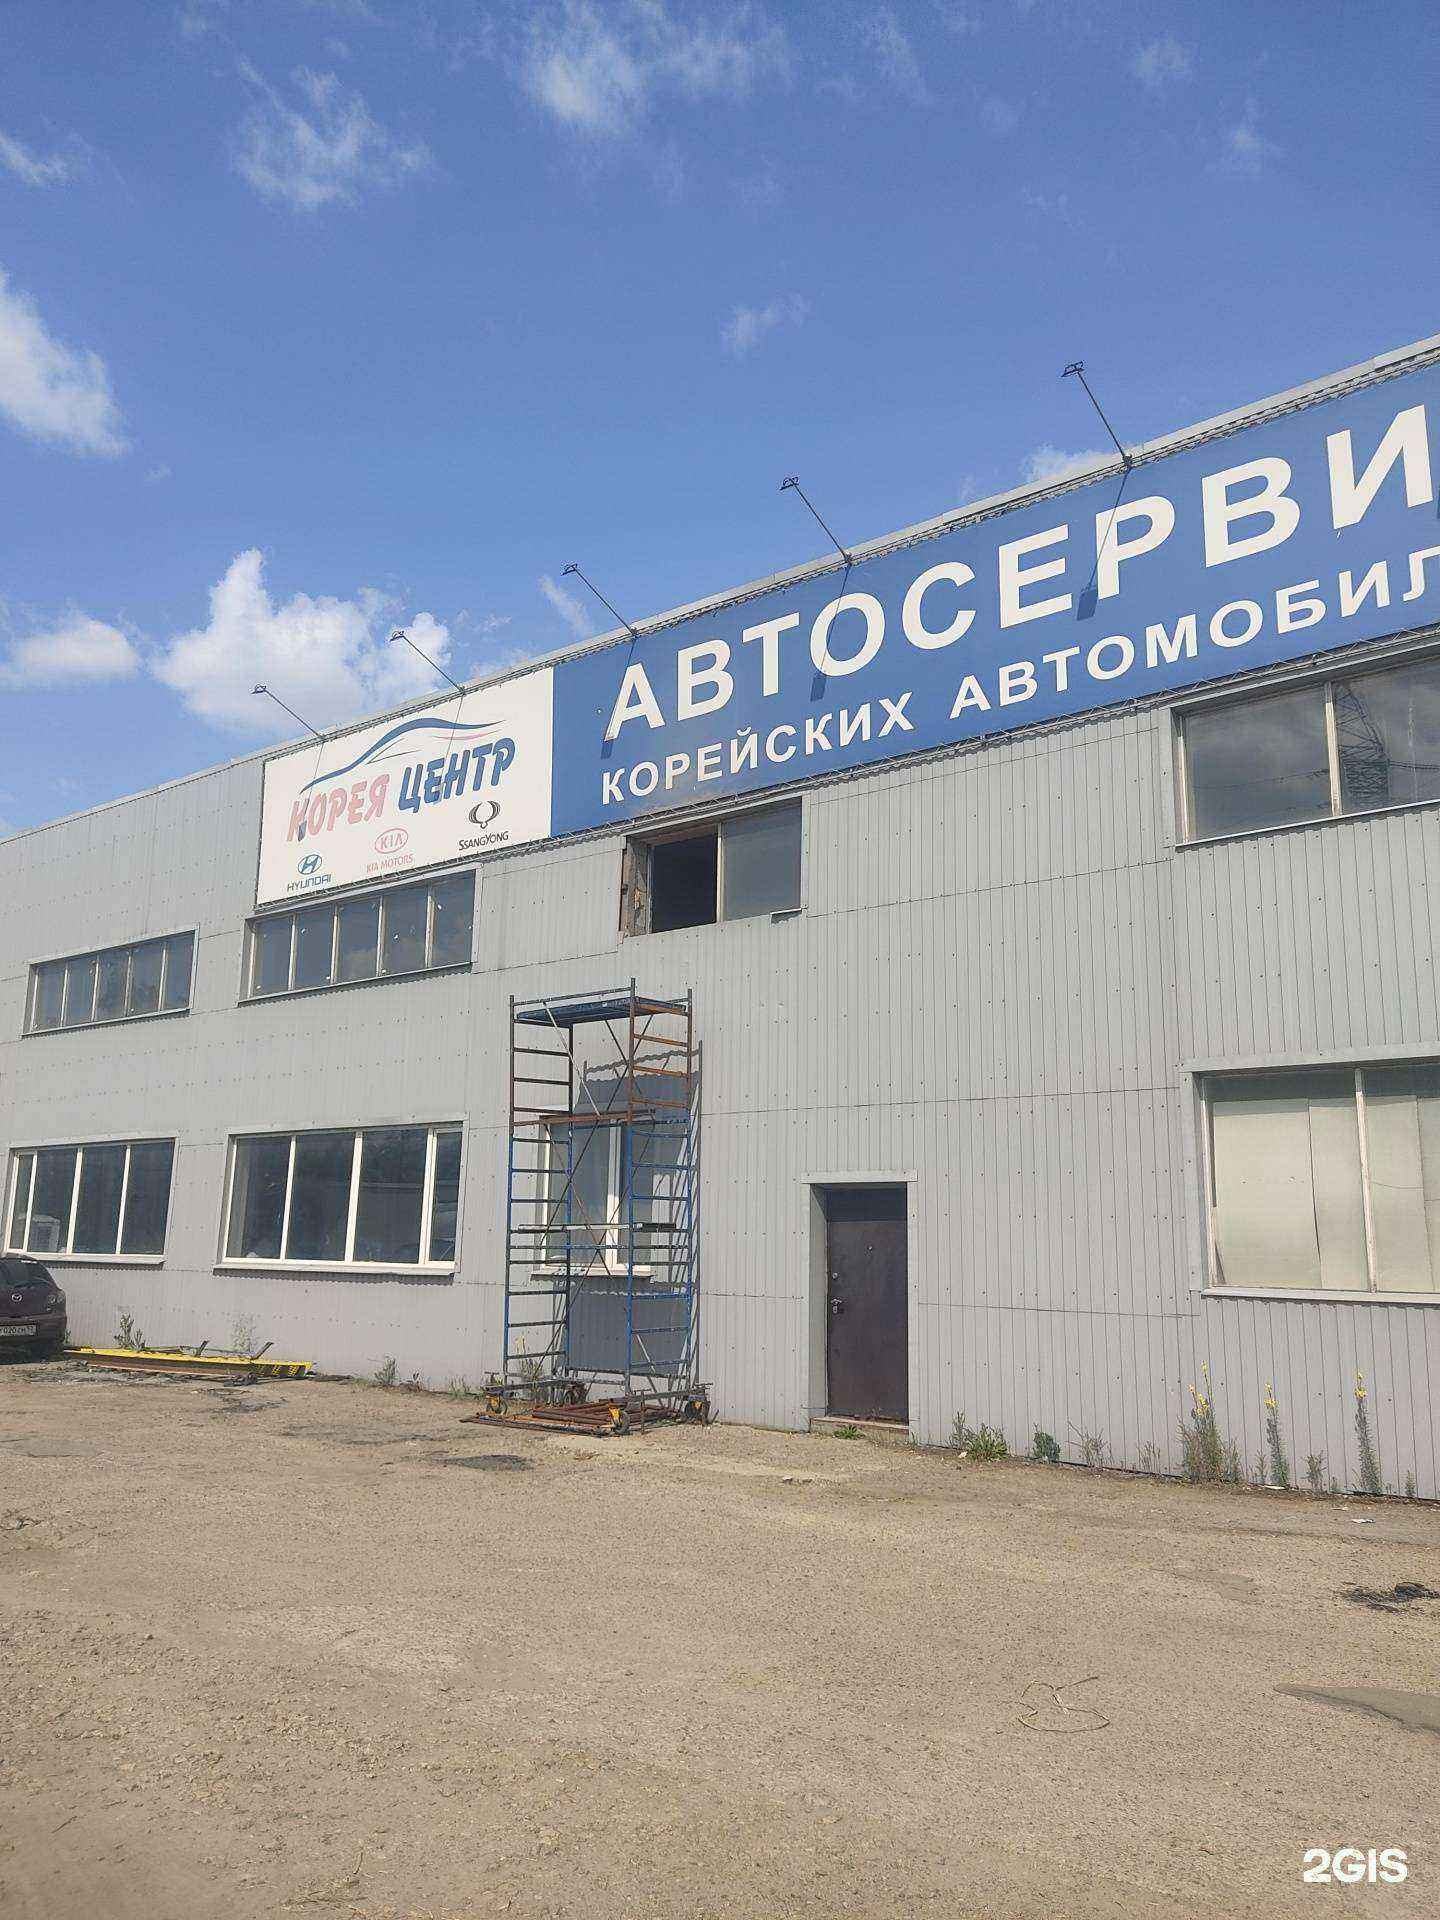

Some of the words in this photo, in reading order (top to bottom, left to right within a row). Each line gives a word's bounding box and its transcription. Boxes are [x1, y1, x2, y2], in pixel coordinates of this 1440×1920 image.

[604, 404, 1433, 742] АВТОСЕРВИ
[286, 774, 390, 842] КОРЕЯ
[398, 737, 516, 813] ЦЕНТР
[602, 692, 914, 805] КОРЕЙСКИХ
[286, 874, 332, 892] HYUNDAI
[366, 862, 380, 874] KIA
[381, 853, 414, 871] MOTORS
